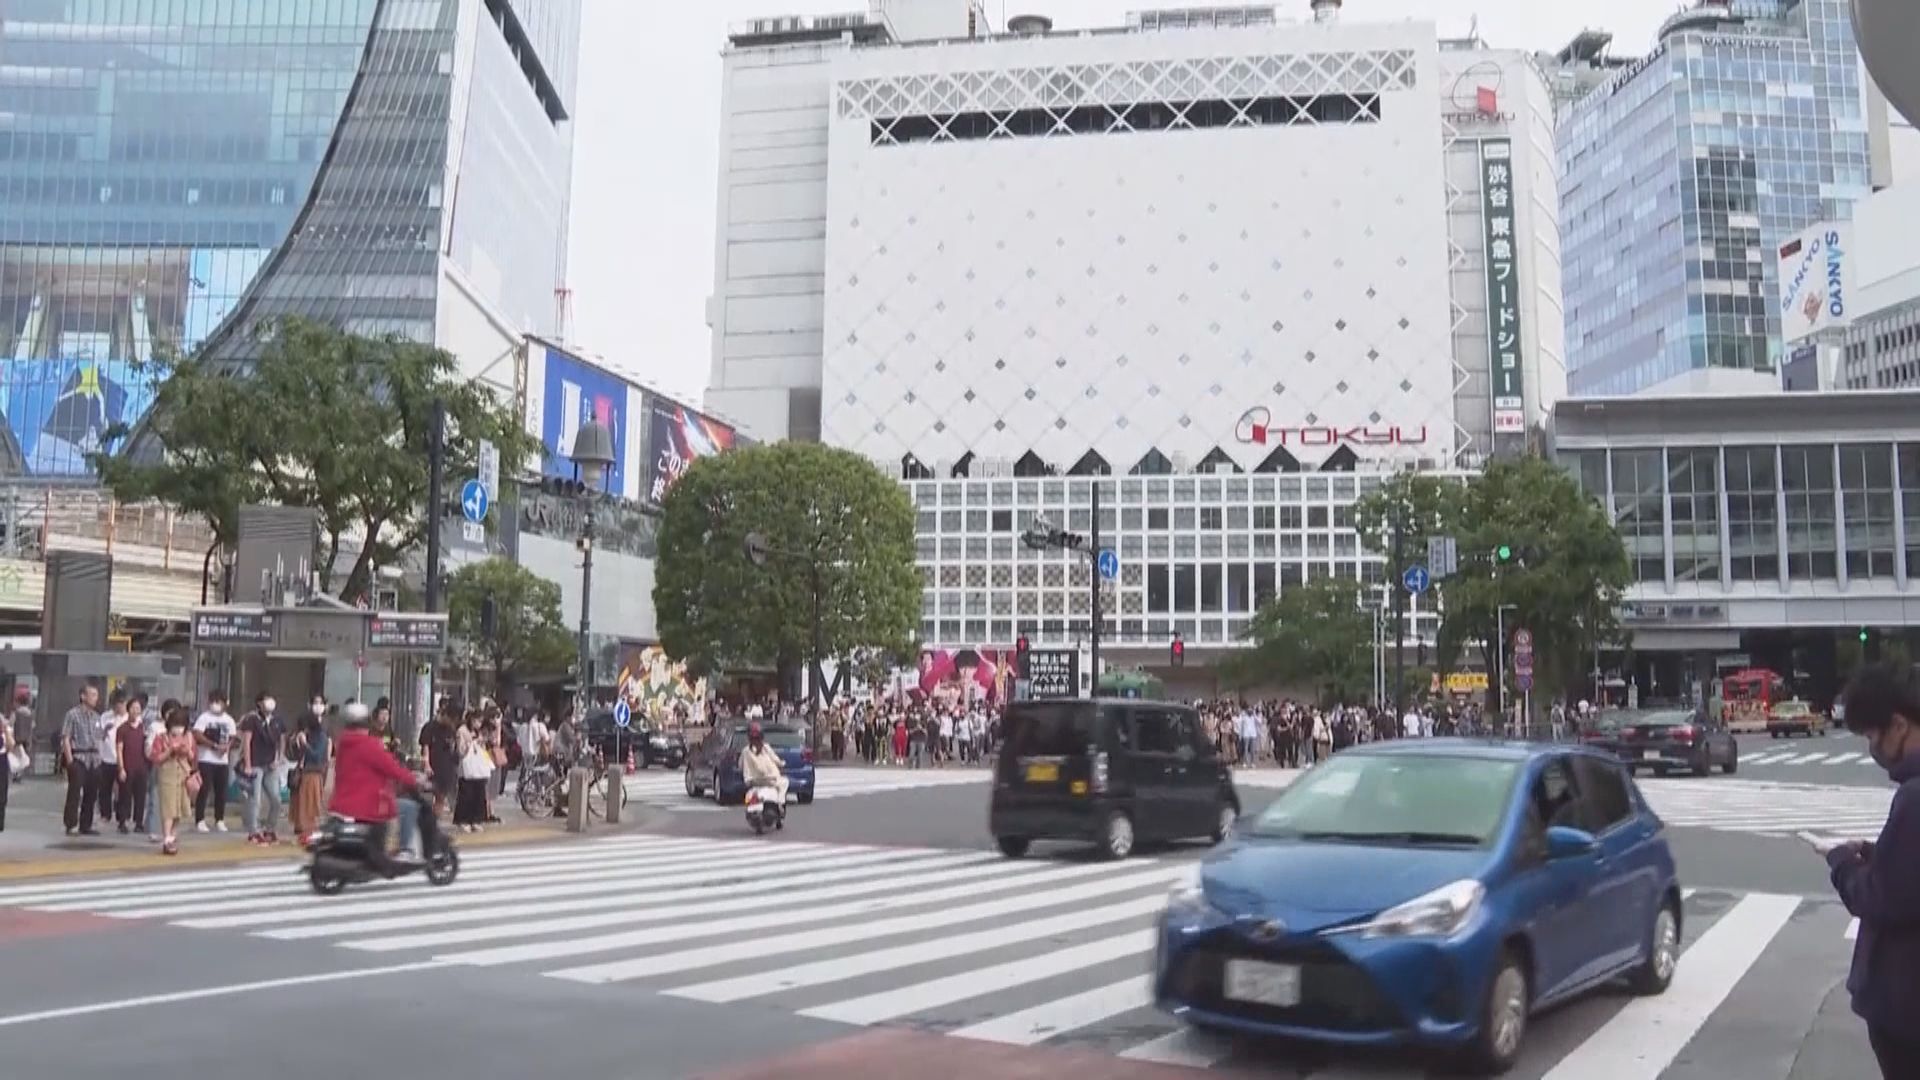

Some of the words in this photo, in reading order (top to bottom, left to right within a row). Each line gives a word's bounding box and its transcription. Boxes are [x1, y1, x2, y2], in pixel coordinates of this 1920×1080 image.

[1491, 215, 1515, 392] 東急フードショー
[1268, 426, 1426, 445] TOKYU
